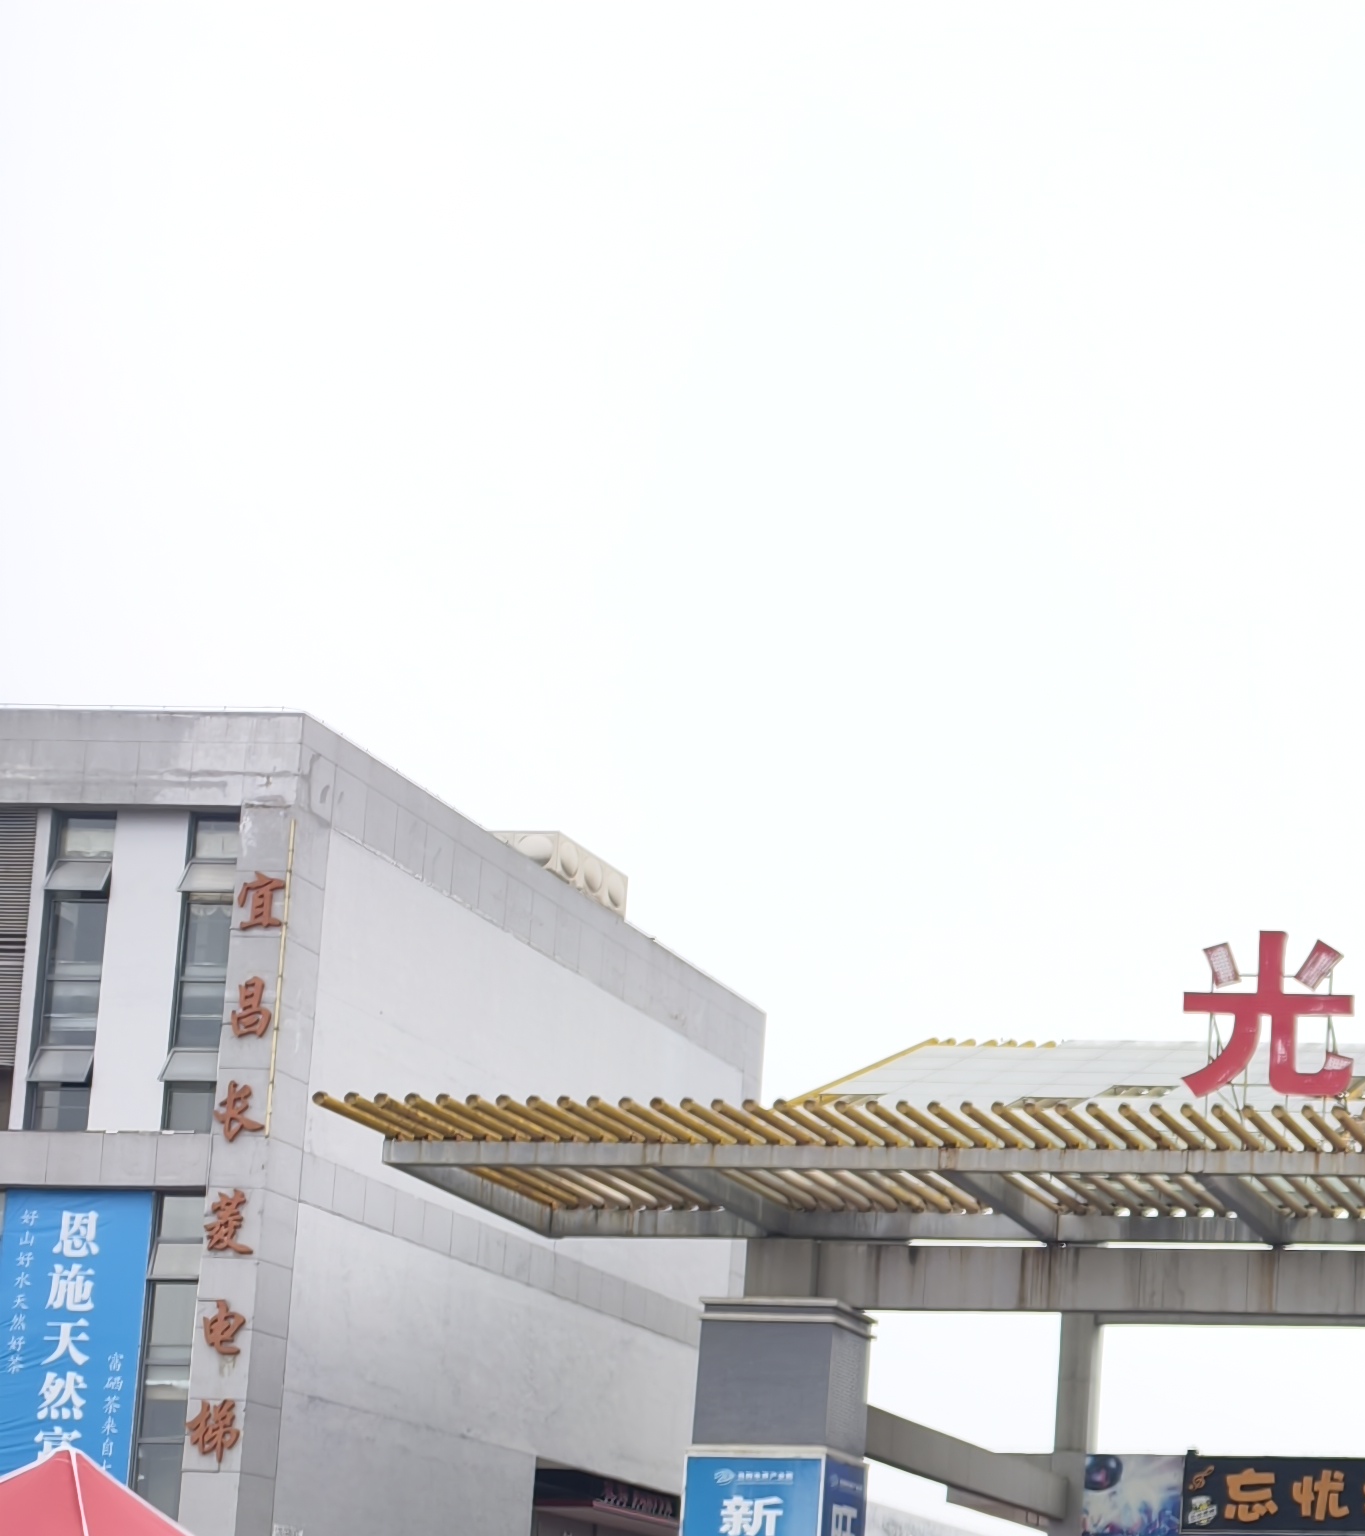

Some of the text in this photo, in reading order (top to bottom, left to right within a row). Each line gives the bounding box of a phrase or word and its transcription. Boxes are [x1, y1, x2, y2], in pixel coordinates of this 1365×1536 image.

[7, 1208, 39, 1375] 好山好水天然好茶
[186, 871, 287, 1465] 宜昌长菱电梯
